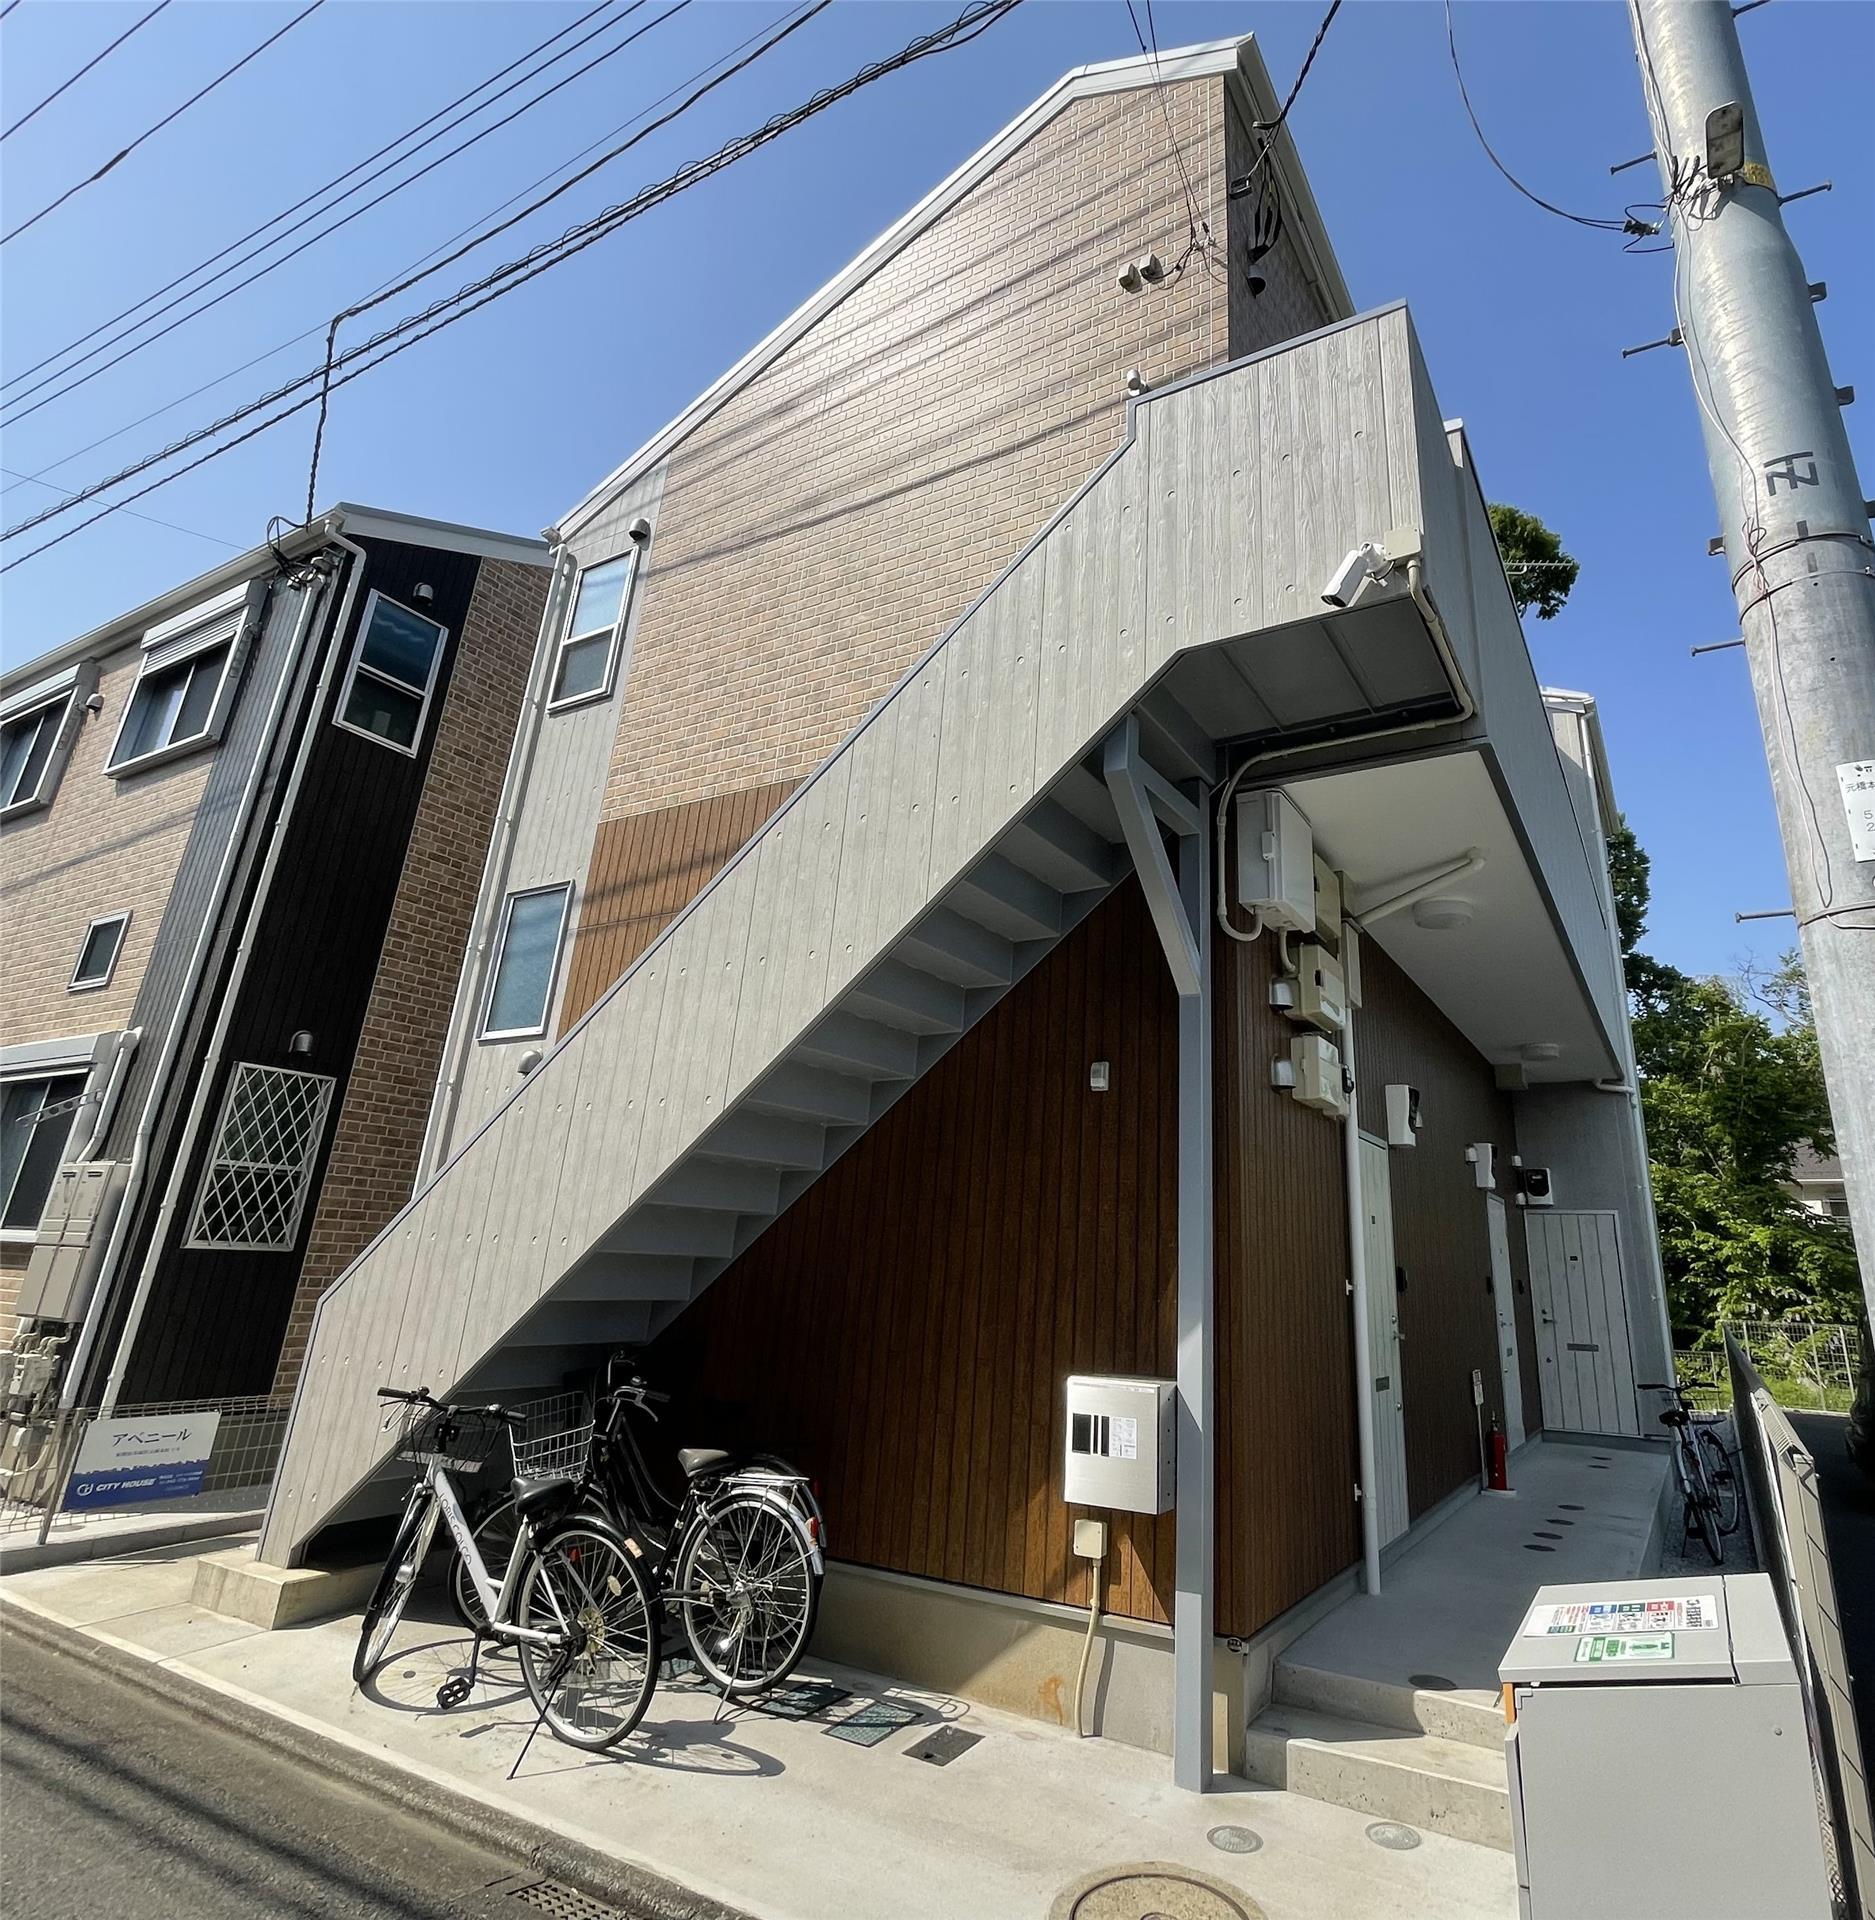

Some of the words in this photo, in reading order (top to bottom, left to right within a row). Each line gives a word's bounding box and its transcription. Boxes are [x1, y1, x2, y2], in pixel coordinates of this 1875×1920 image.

[113, 1428, 192, 1447] アベニール
[95, 1482, 121, 1493] CITY
[121, 1478, 157, 1489] HOUSE
